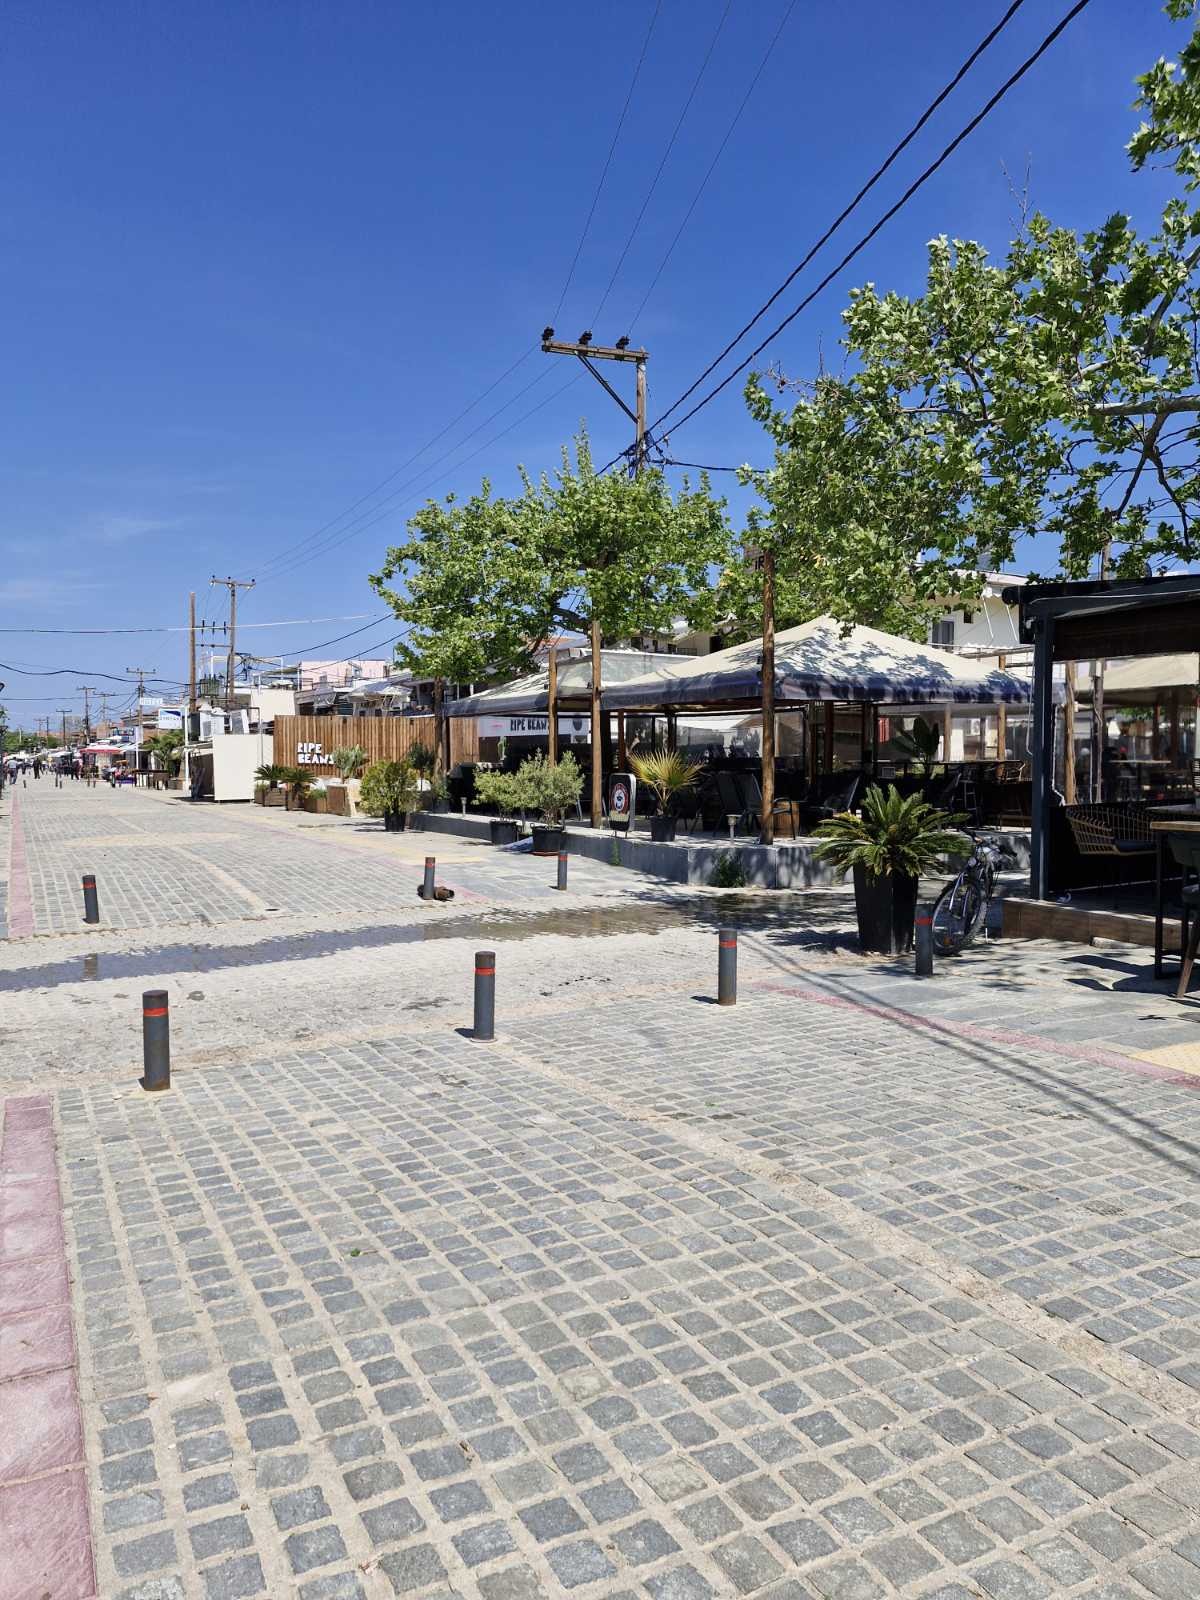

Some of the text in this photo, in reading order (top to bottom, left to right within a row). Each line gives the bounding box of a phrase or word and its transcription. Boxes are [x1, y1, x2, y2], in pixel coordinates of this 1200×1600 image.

[510, 718, 526, 731] RIPE
[527, 718, 549, 731] BEAN
[297, 742, 322, 754] RIPE
